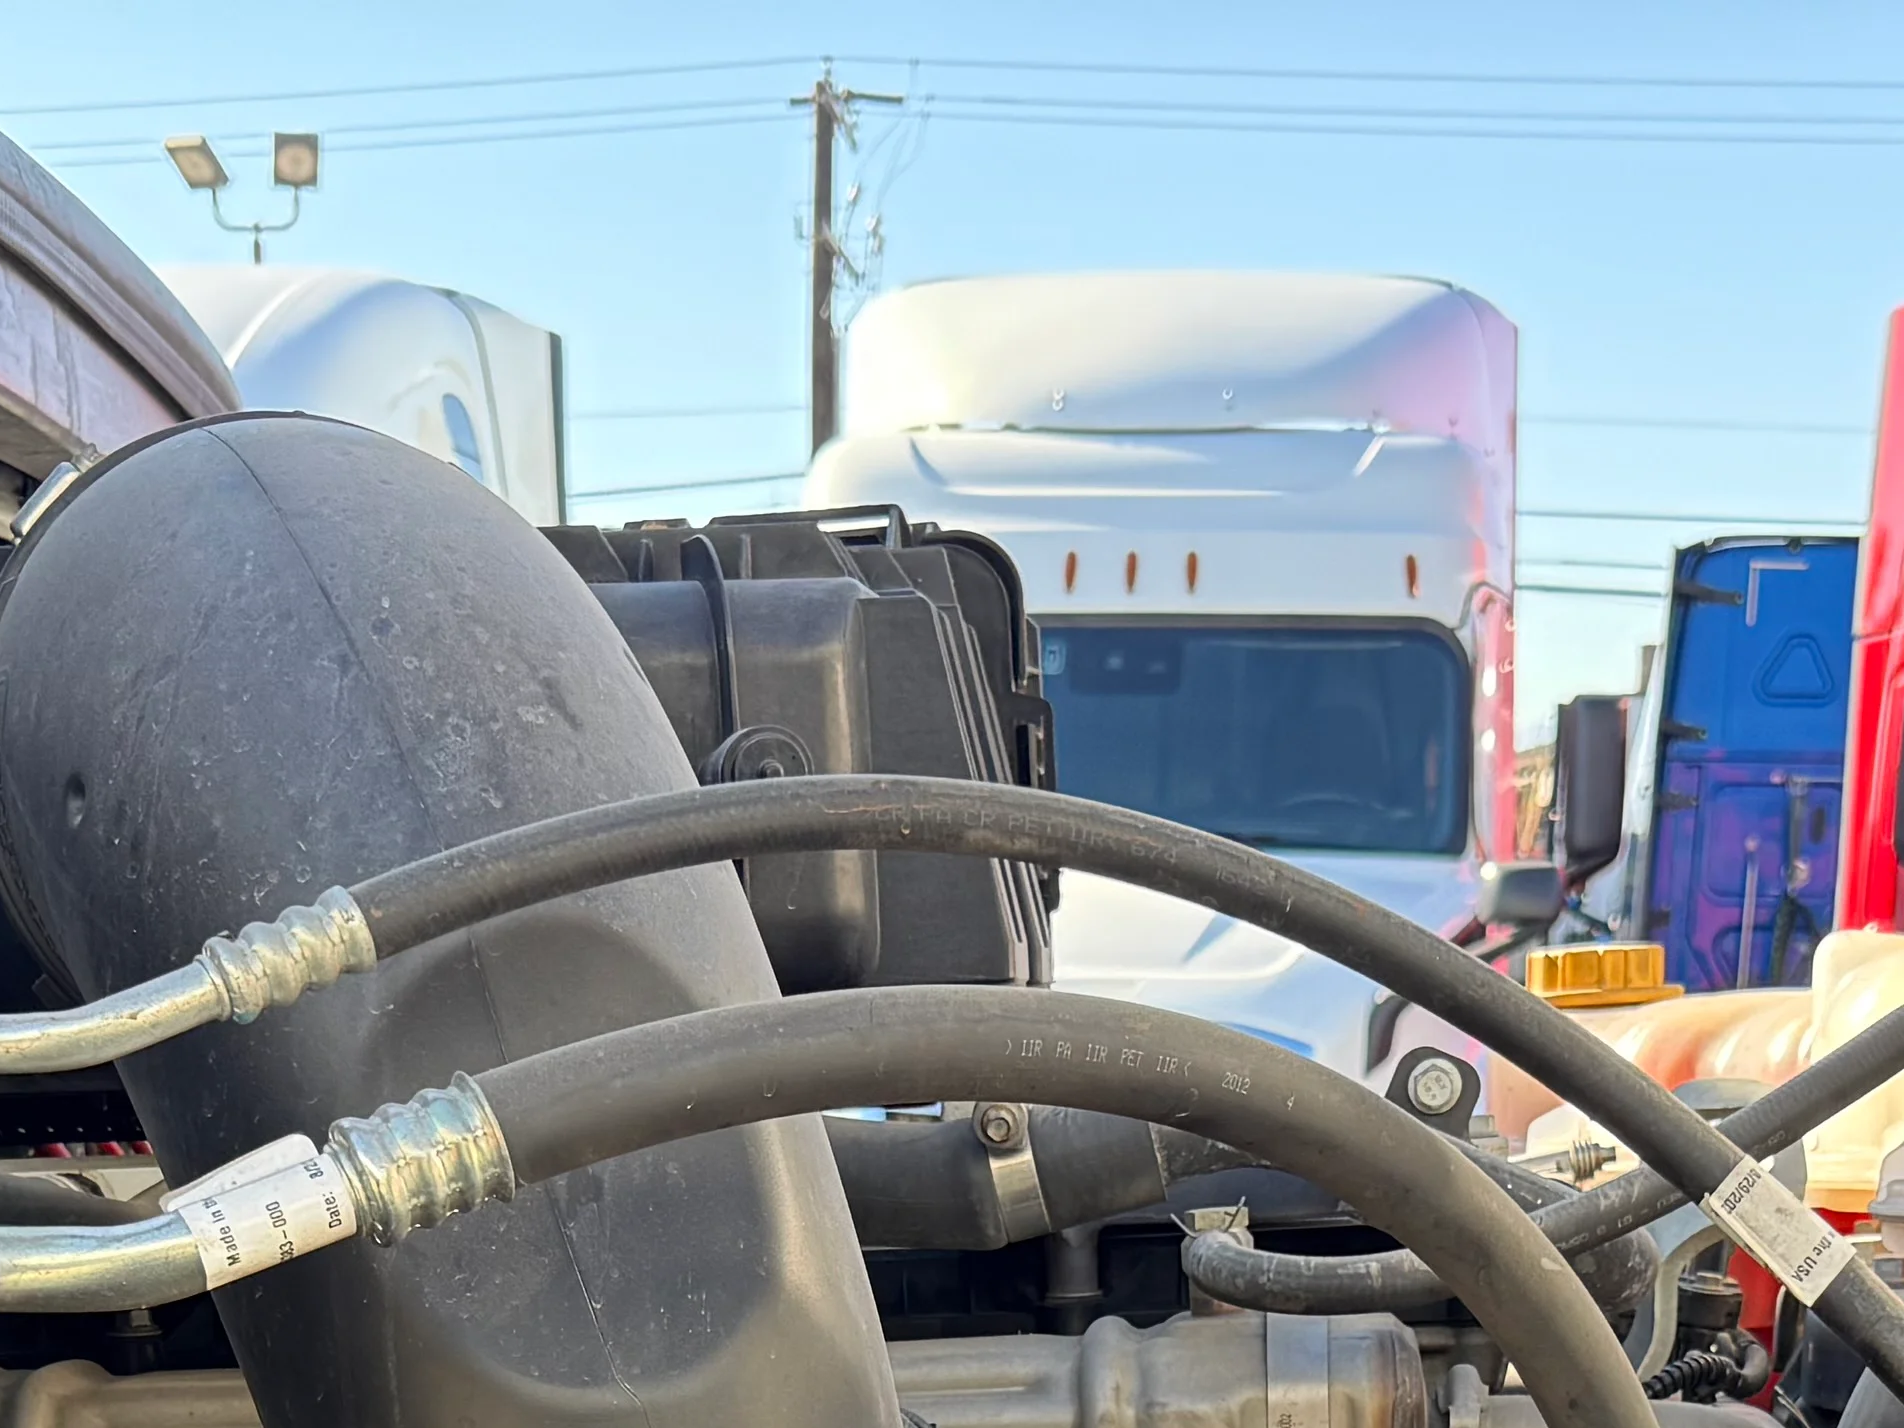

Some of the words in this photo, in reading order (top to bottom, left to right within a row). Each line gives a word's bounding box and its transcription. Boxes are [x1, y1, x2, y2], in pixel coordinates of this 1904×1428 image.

[1120, 1049, 1144, 1069] PET
[322, 1191, 342, 1228] Date:
[219, 1226, 241, 1266] Made
[1792, 1257, 1817, 1283] USA
